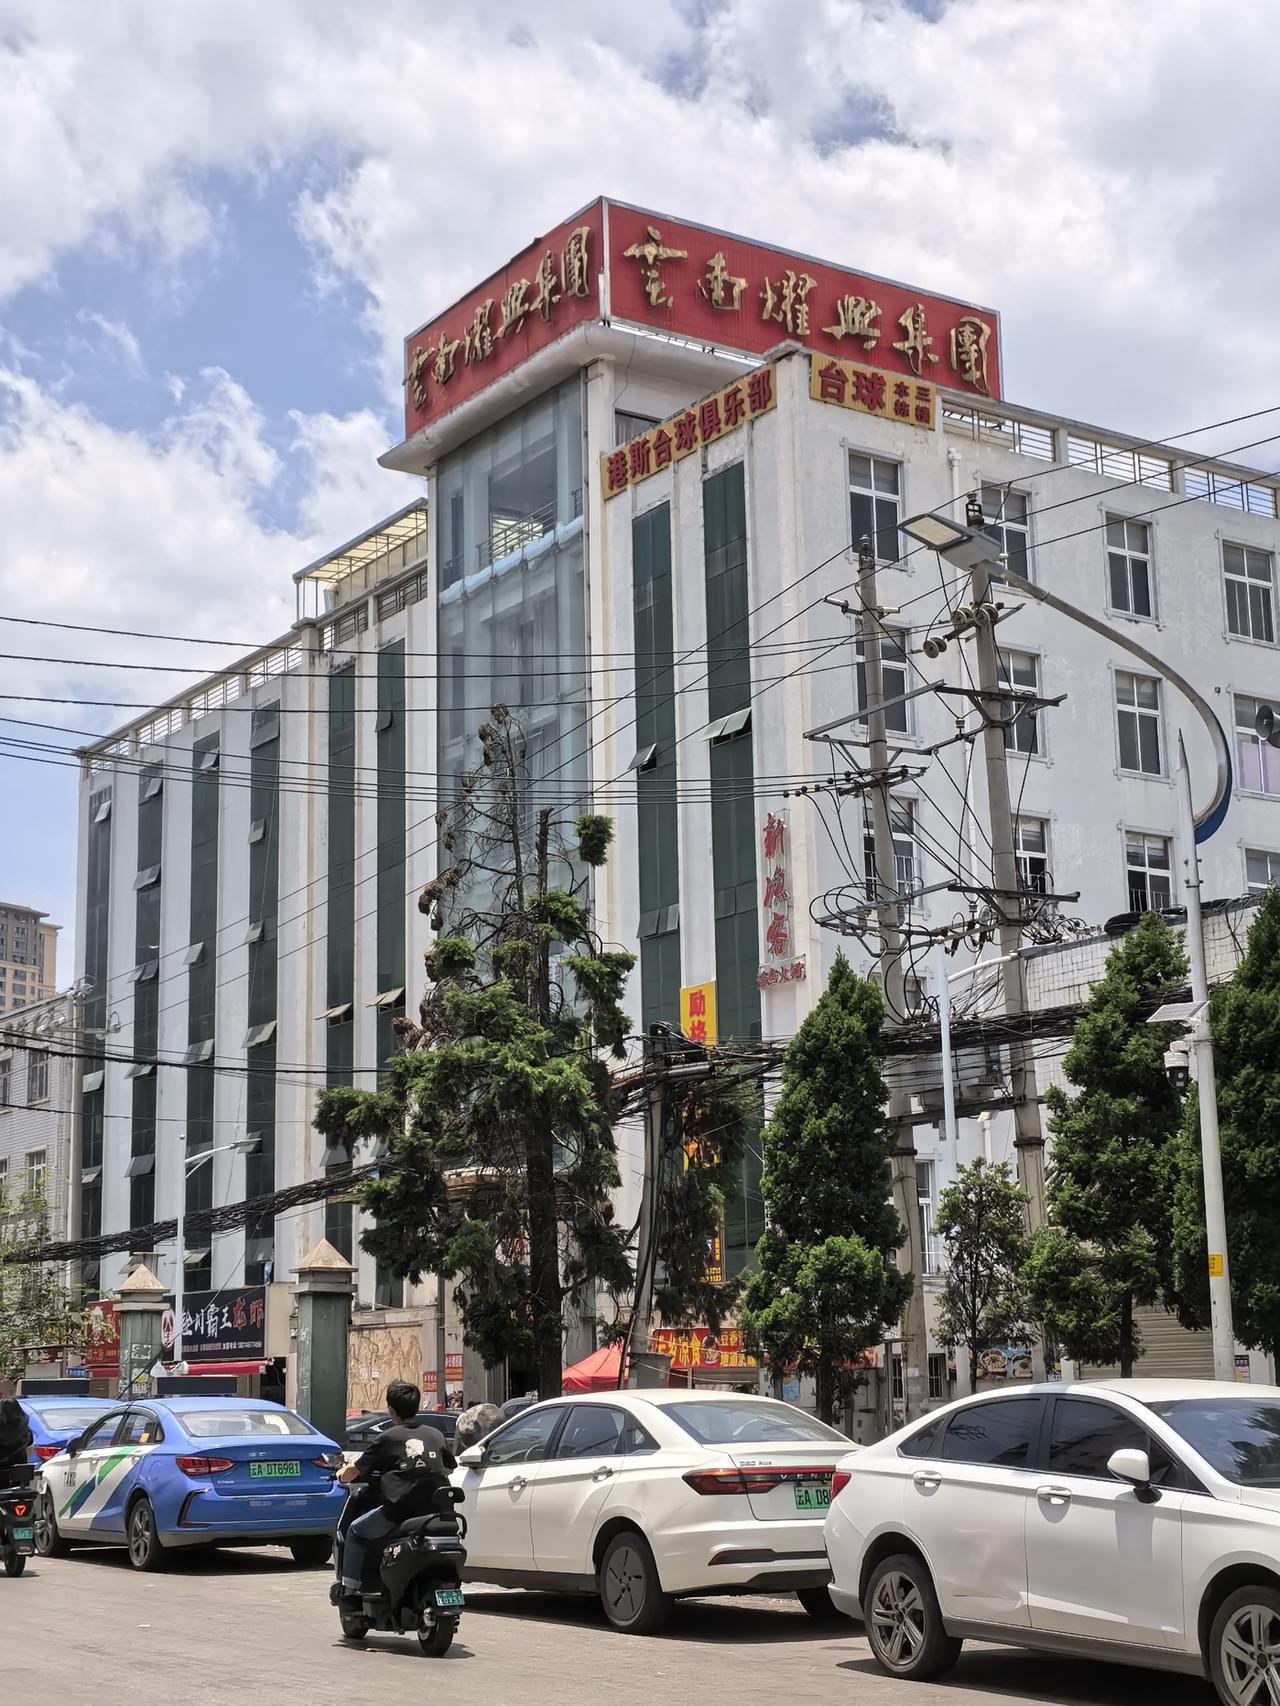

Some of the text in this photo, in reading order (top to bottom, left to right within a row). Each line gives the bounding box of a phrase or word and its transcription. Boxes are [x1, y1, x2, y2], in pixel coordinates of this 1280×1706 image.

[818, 361, 887, 411] 台球
[607, 369, 772, 491] 港斯台球俱乐部
